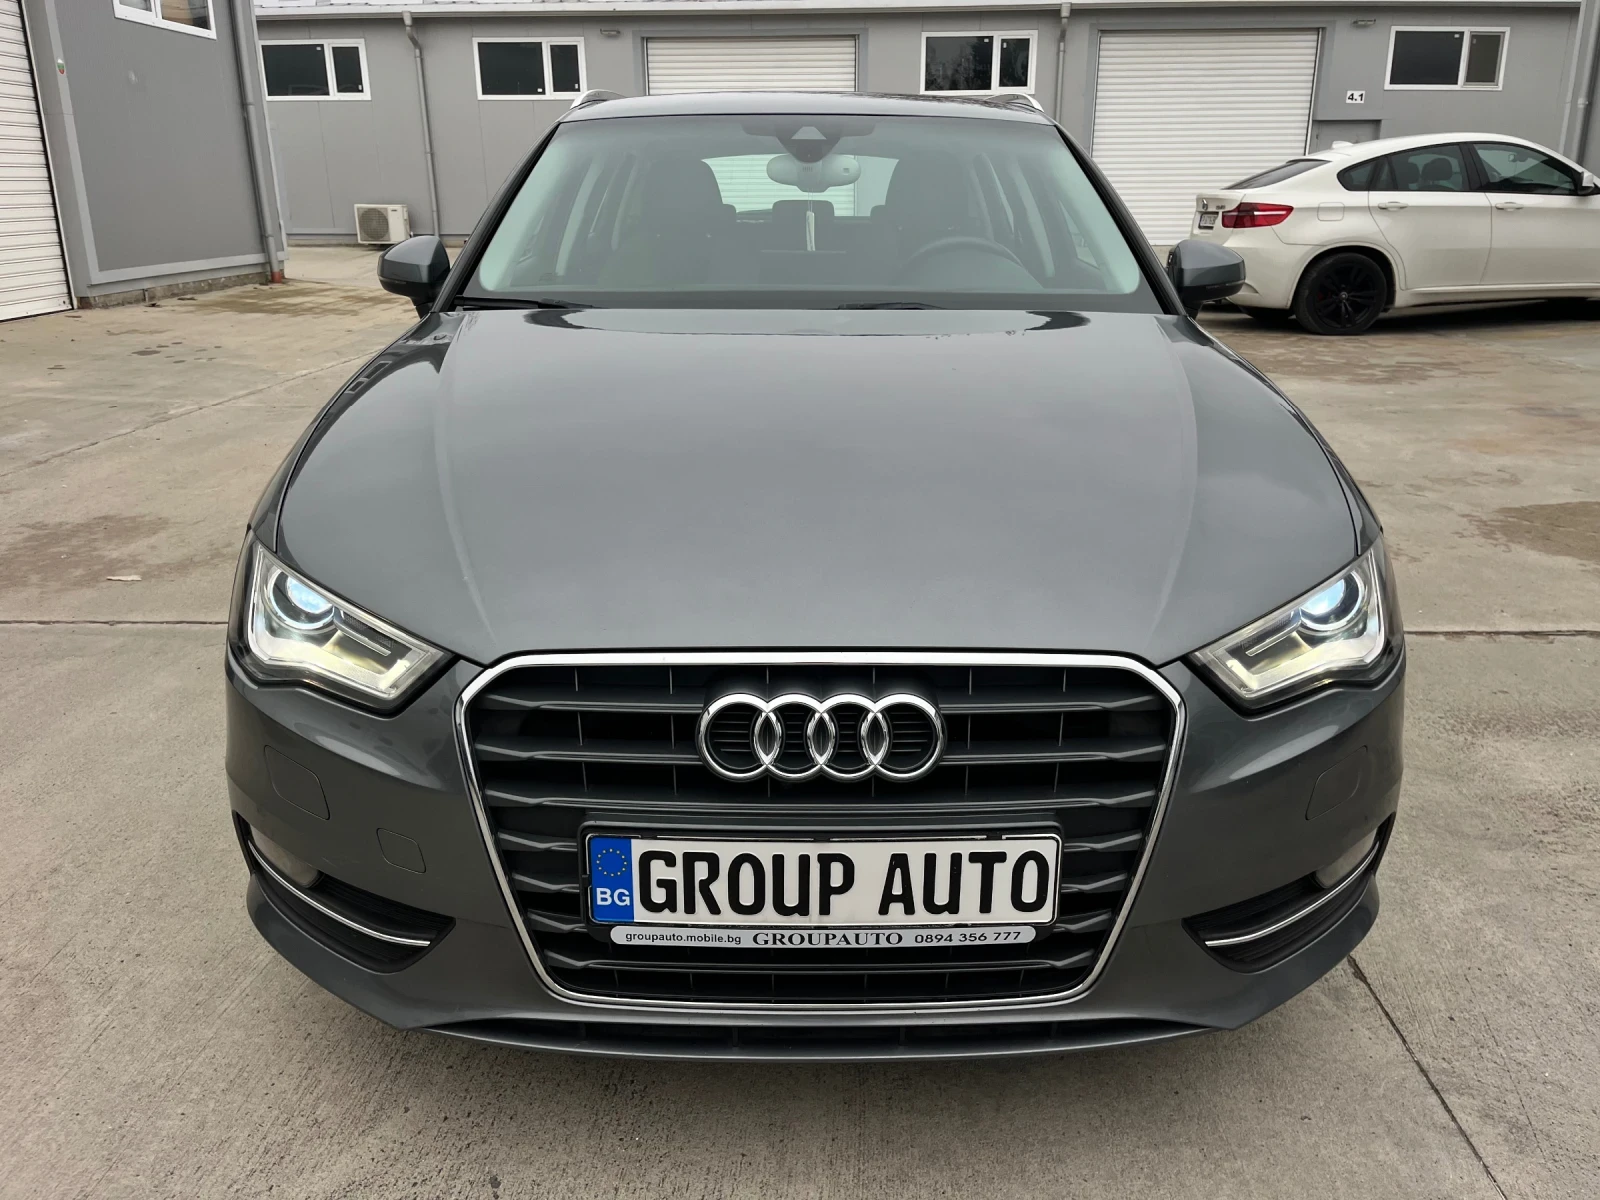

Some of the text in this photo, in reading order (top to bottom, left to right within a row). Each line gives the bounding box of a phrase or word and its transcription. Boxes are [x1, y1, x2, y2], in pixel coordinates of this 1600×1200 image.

[1347, 92, 1364, 102] 4.1
[638, 850, 1050, 917] GROUP AUTO
[596, 887, 631, 906] BG
[625, 931, 1021, 946] groupauto.mobile.bg GROUPAUTO 0894 356 777
